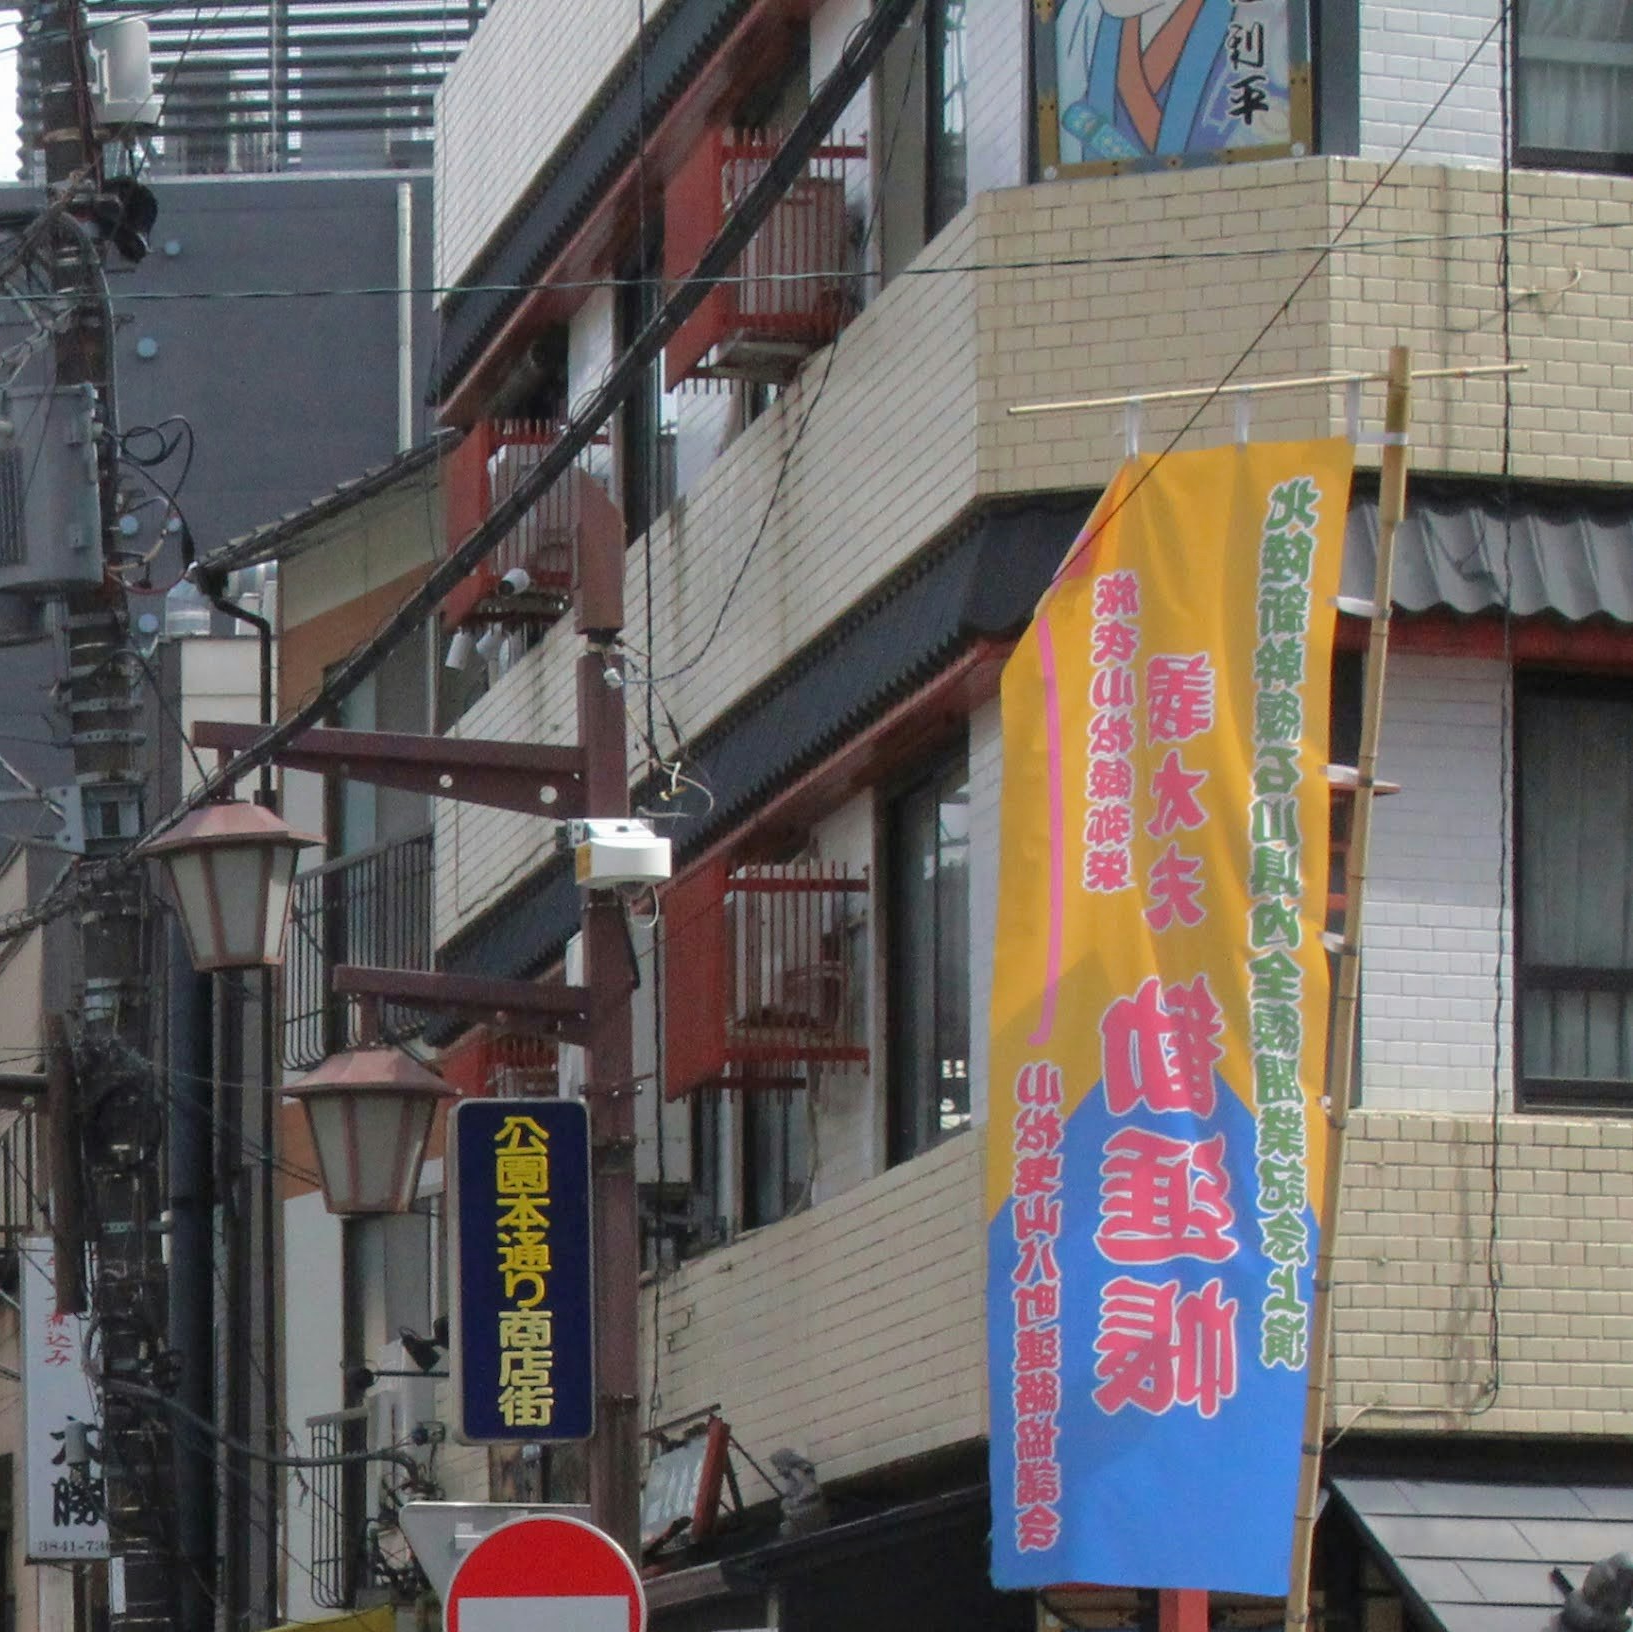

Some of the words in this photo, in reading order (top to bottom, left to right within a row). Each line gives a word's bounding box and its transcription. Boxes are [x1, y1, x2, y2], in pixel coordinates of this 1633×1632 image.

[494, 1116, 554, 1427] 公園本通り商店街
